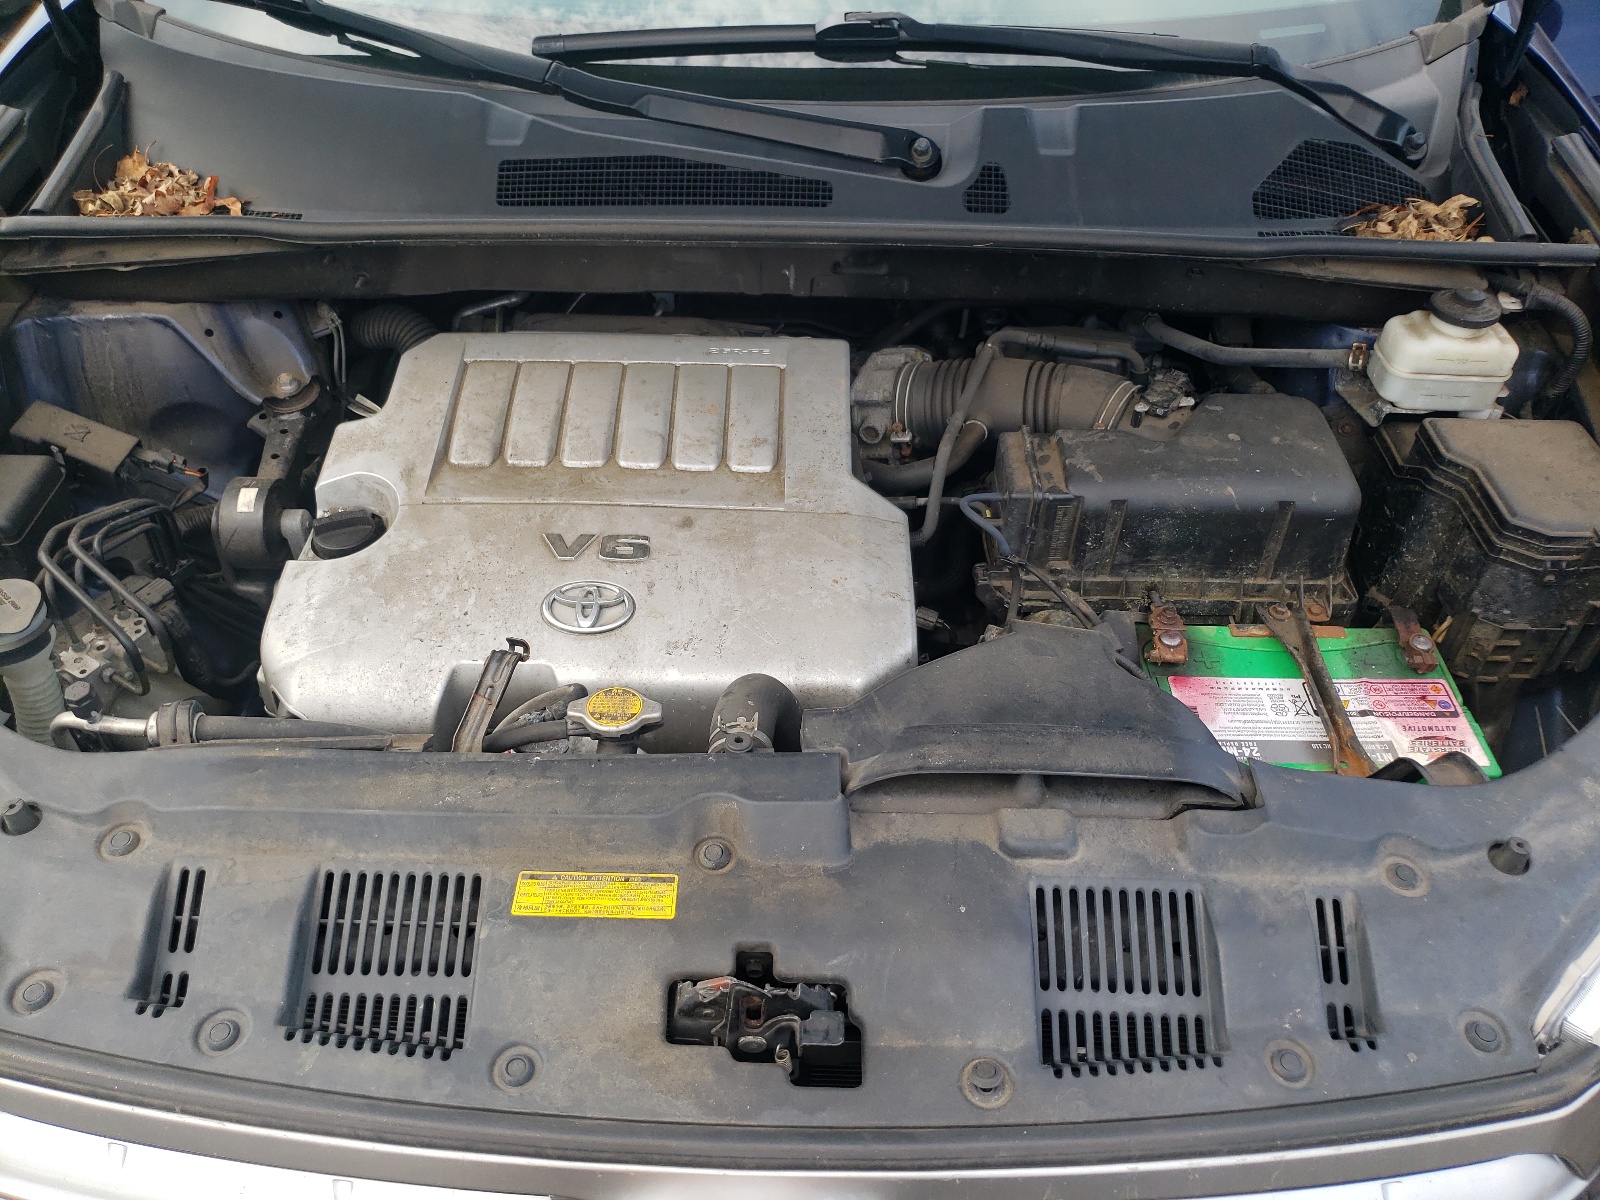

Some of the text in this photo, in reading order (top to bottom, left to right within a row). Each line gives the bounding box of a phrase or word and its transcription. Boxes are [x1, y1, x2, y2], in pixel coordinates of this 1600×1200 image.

[542, 533, 651, 563] V6
[1410, 739, 1465, 747] BATTERIES
[1407, 746, 1472, 754] INTERSTATE
